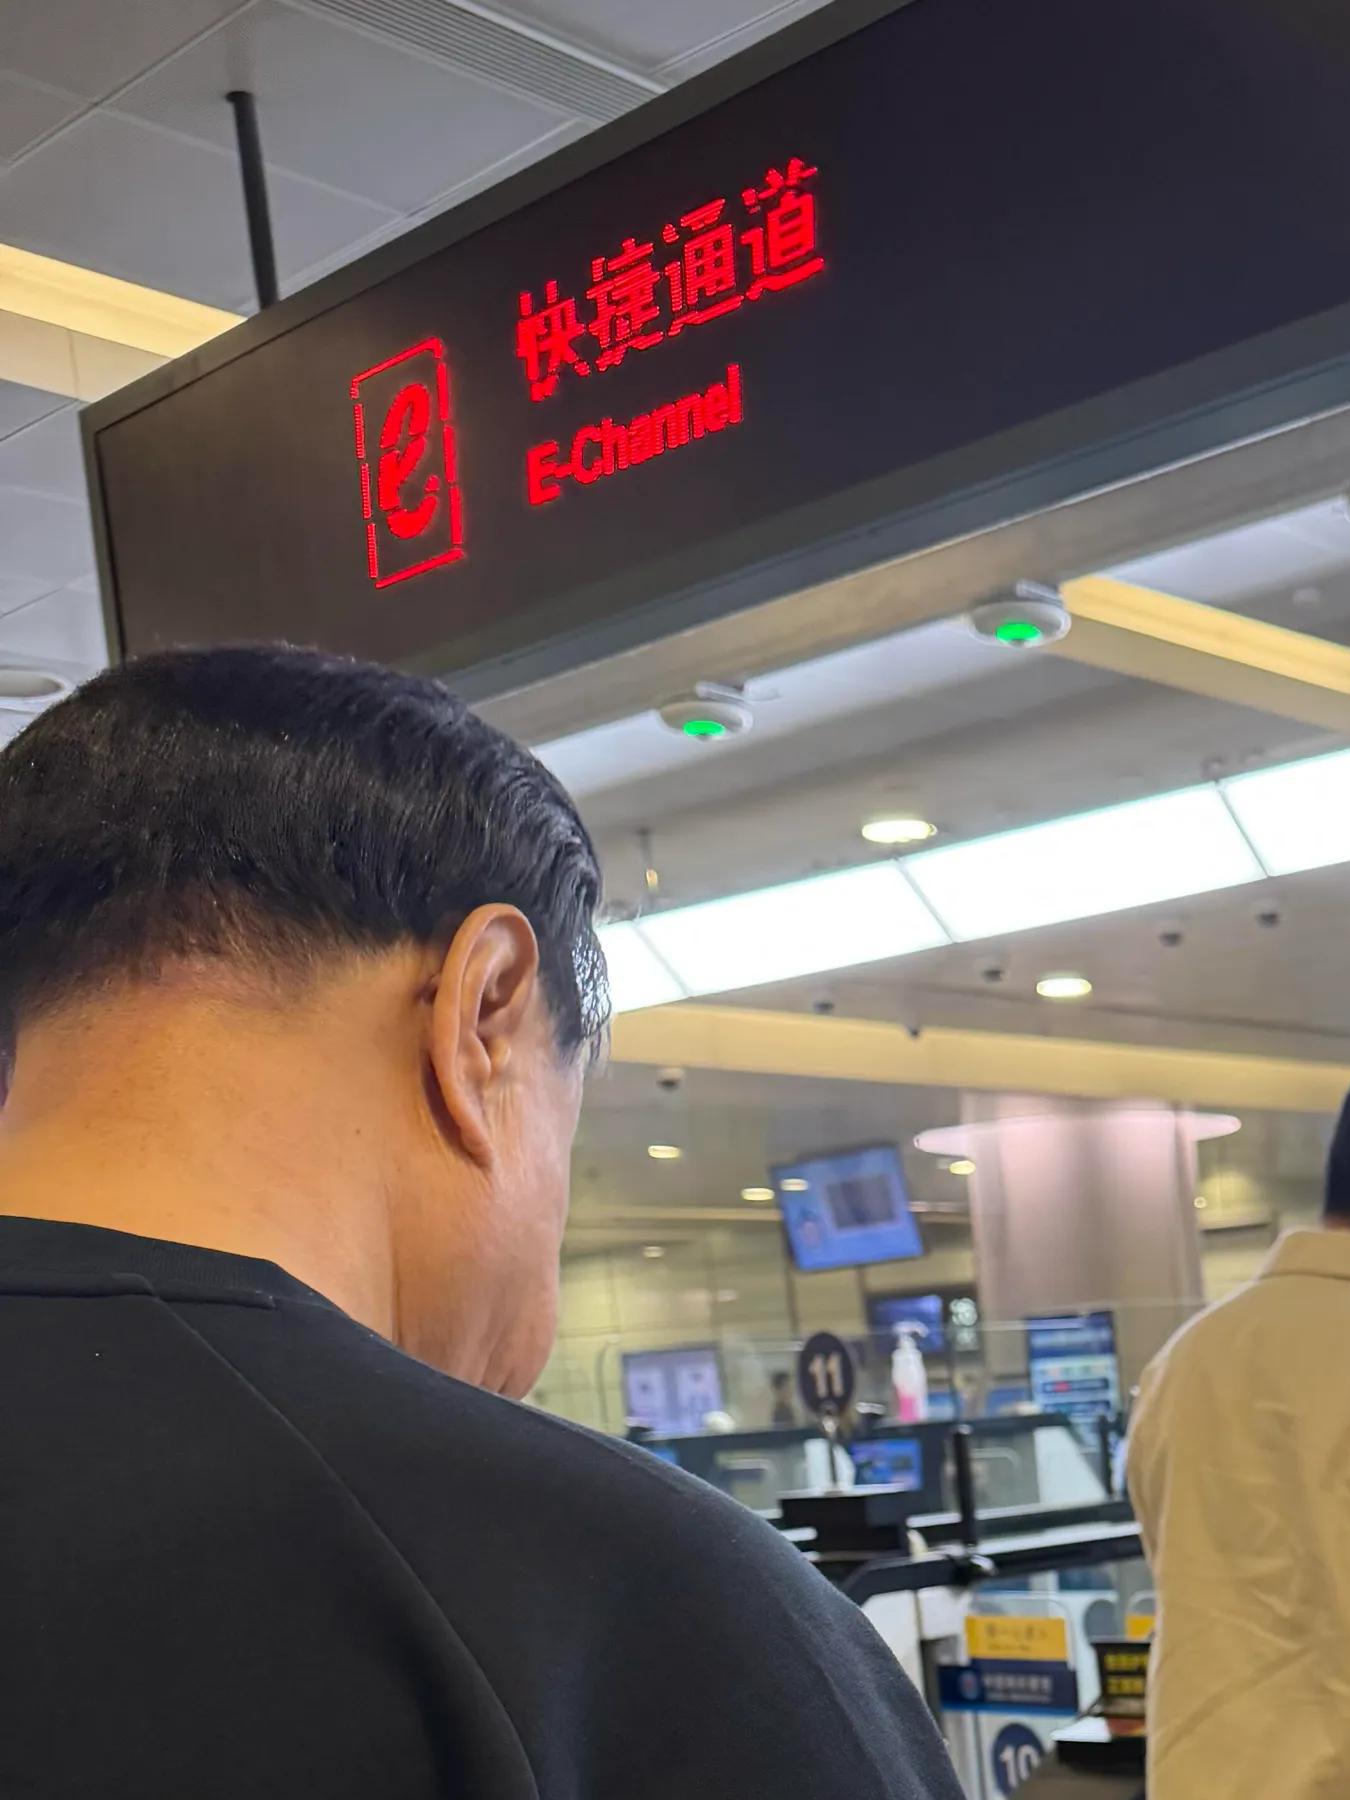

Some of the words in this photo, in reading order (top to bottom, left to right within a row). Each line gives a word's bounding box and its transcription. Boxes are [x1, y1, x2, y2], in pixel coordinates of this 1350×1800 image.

[516, 157, 826, 401] 快捷通道
[526, 363, 743, 504] E-Channel
[808, 1352, 844, 1398] 11
